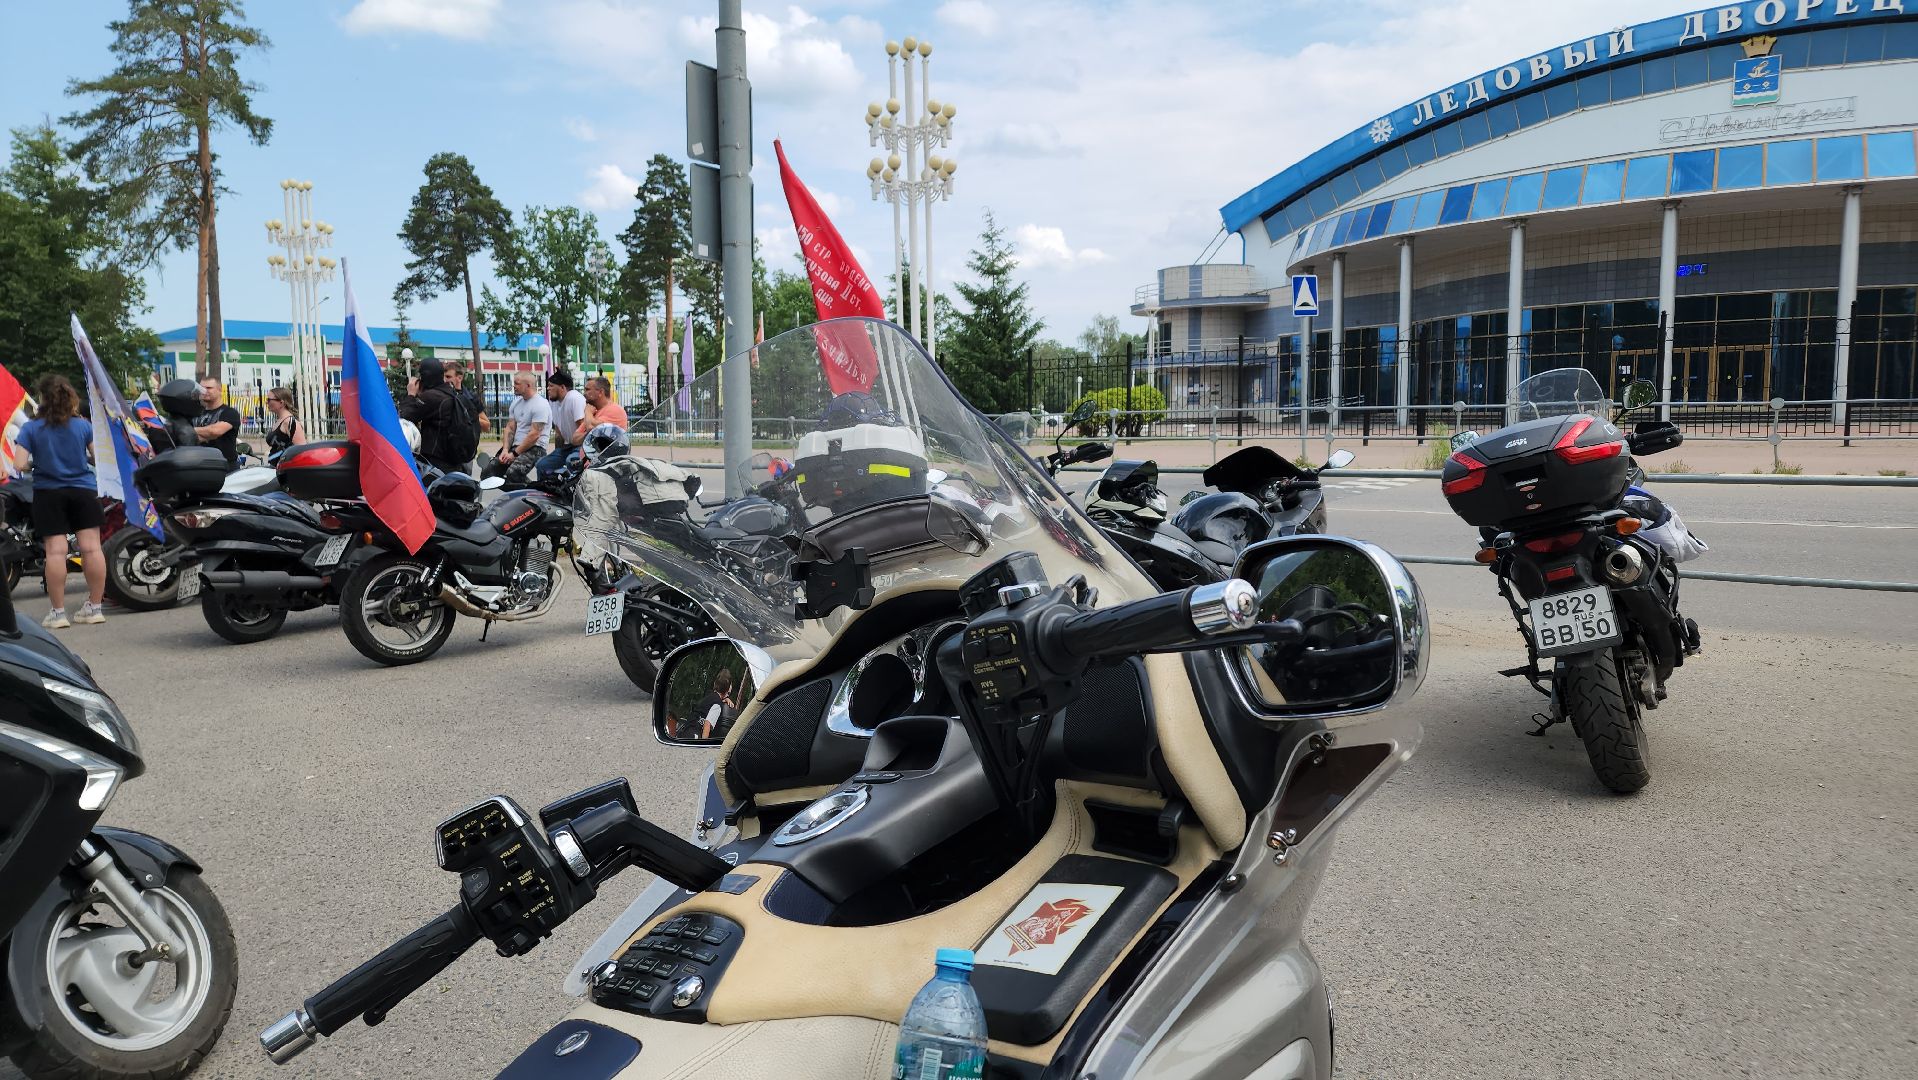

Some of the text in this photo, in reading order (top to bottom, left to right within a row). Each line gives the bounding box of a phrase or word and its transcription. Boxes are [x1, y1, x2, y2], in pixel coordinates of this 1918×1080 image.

[1412, 25, 1635, 126] ЛЕДОВЫЙ
[813, 243, 832, 264] СТР.
[804, 256, 841, 292] ТУЗОВА
[815, 288, 833, 309] ДИВ.
[510, 508, 535, 527] SUZUKI
[593, 597, 617, 614] 5258
[1542, 594, 1597, 619] 8829
[605, 616, 618, 630] 50
[1574, 611, 1595, 621] RUS
[1581, 618, 1611, 638] 50
[974, 661, 991, 669] CRUISE
[974, 666, 995, 675] CONTROL
[981, 680, 994, 688] RVS
[500, 843, 521, 858] VOLUME
[530, 901, 546, 913] MUTE
